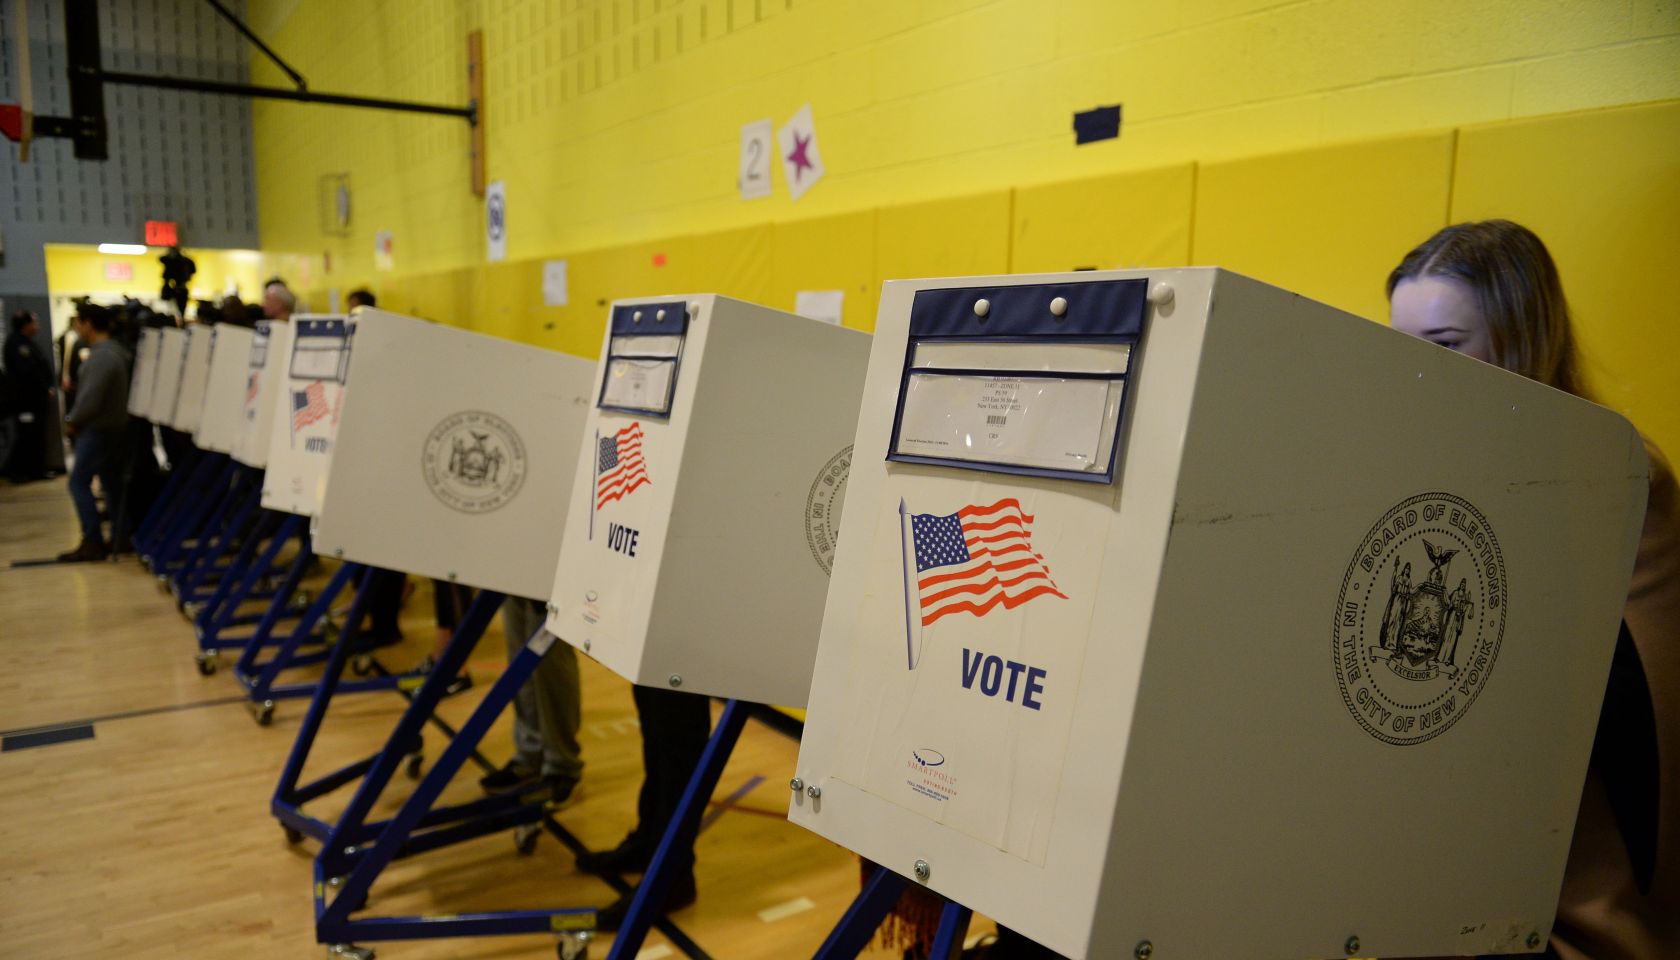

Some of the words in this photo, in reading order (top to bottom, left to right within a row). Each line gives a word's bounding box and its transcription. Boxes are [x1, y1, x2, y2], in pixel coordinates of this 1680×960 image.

[746, 138, 763, 181] 2
[812, 502, 825, 519] IN
[607, 521, 640, 558] VOTE
[813, 523, 832, 554] THE
[1361, 509, 1418, 573] BOARD
[1423, 504, 1446, 522] OF
[1449, 508, 1500, 610] ELECTIONS
[1343, 602, 1358, 627] IN
[1343, 634, 1362, 685] THE
[1393, 664, 1432, 680] EXCELSIOR
[1458, 638, 1494, 697] YORK
[961, 647, 1048, 712] VOTE
[1356, 687, 1392, 727] CITY
[1392, 716, 1416, 733] OF
[1419, 696, 1457, 731] NEW
